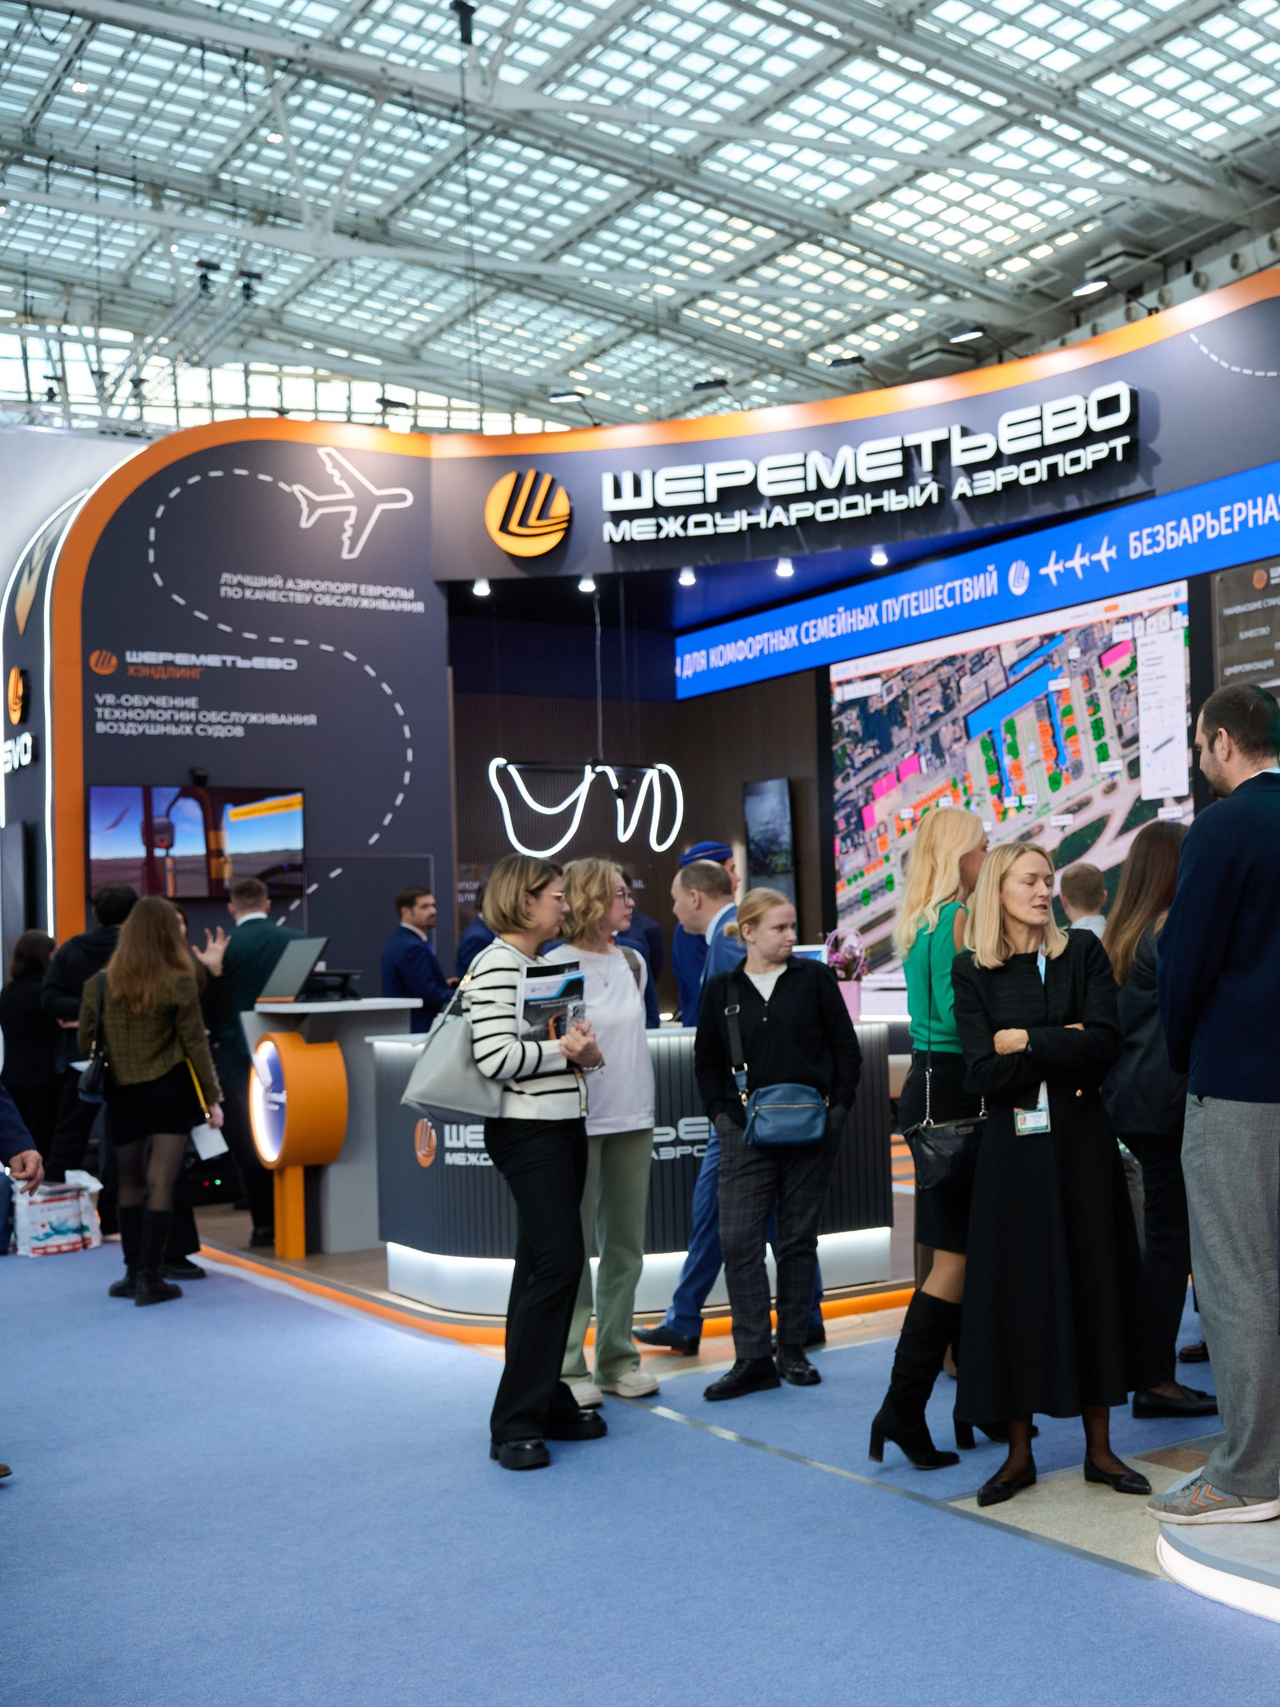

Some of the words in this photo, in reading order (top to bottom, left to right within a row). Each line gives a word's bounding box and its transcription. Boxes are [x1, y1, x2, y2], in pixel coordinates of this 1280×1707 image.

[602, 380, 1132, 512] ШЕРЕМЕТЬЕВО
[602, 476, 939, 543] МЕЖДУНАРОДНЫЙ
[951, 435, 1131, 500] АЭРОПОРТ
[220, 586, 243, 599] ПО
[244, 587, 312, 604] КАЧЕСТВУ
[313, 593, 425, 613] ОБСЛУЖИВАНИЯ
[285, 578, 358, 595] АЭРОПОРТ
[359, 584, 415, 600] ЕВРОПЫ
[682, 649, 708, 680] ДЛЯ
[709, 624, 799, 669] КОМФОРТНЫХ
[800, 602, 879, 645] СЕМЕЙНЫХ
[881, 564, 999, 624] ПУТЕШЕСТВИЙ
[125, 650, 298, 671] ШЕРЕМЕТЬЕВО
[94, 693, 200, 709] VR-ОБУЧЕНИЕ
[94, 707, 197, 722] ТЕХНОЛОГИИ
[198, 710, 318, 726] ОБСЛУЖИВАНИЯ
[95, 721, 194, 737] ВОЗДУШНЫХ
[195, 726, 245, 738] СУДОВ
